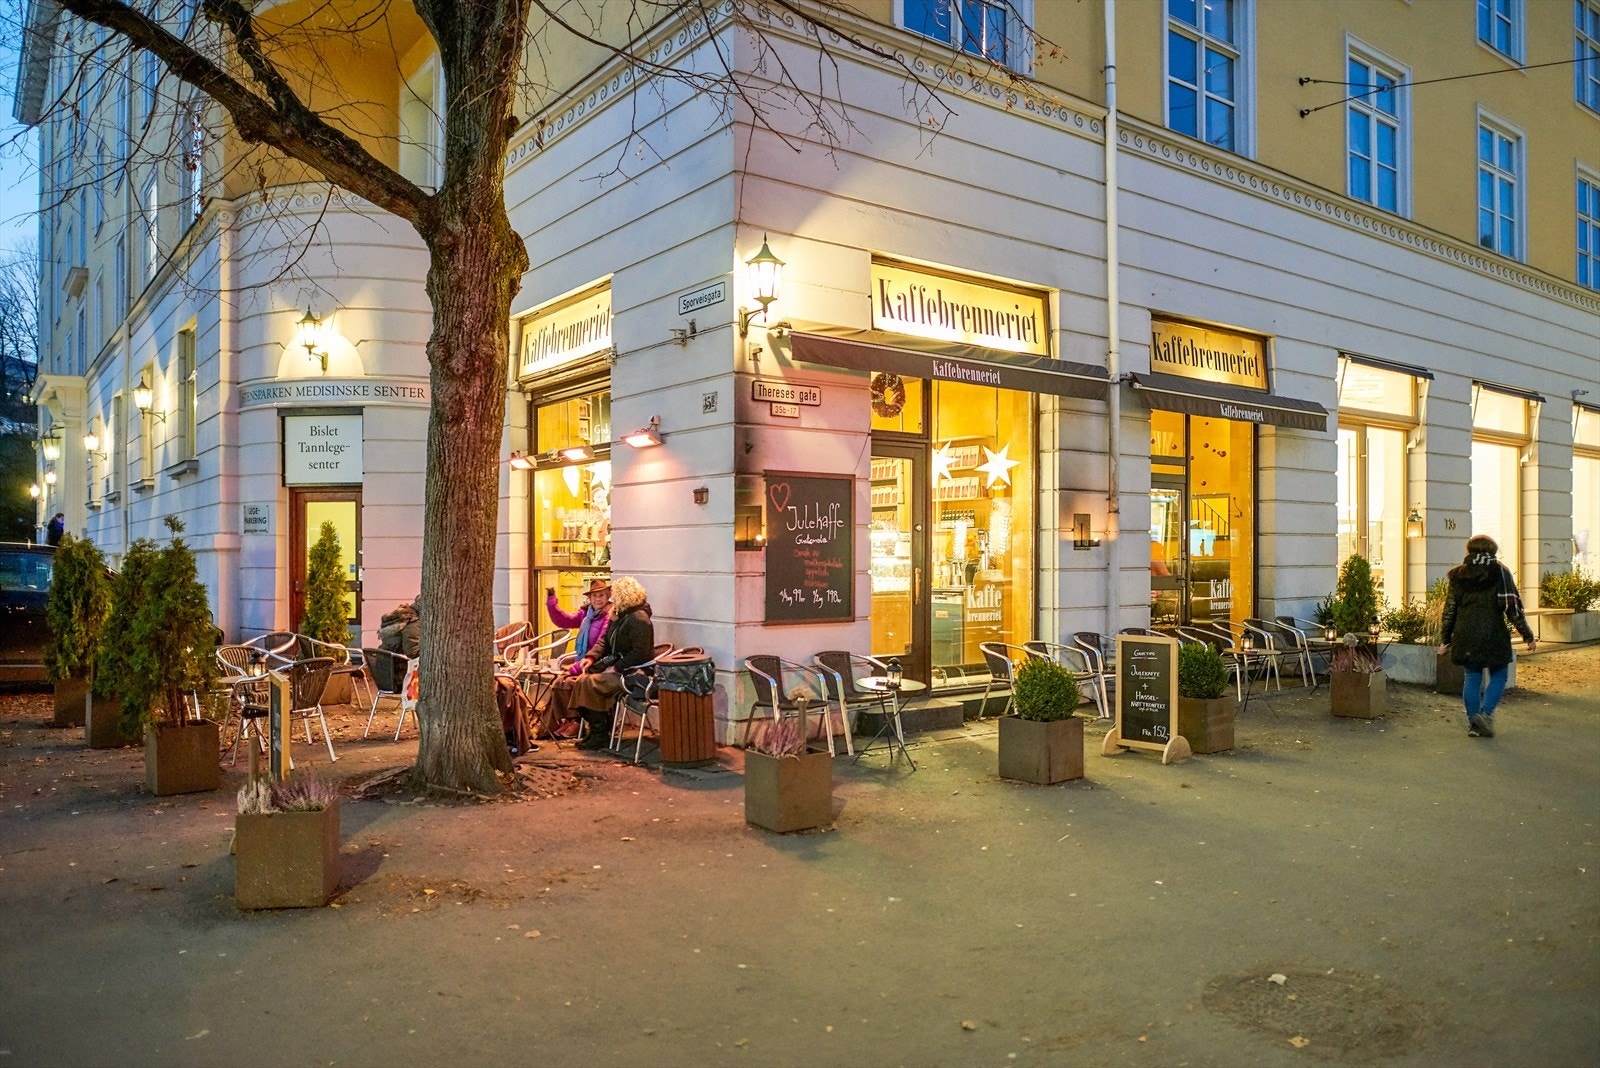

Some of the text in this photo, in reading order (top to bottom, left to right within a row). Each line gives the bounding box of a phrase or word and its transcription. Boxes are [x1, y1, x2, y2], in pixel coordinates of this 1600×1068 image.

[682, 289, 721, 311] Sporveisgata
[878, 278, 1039, 344] Kaffebrenneriet
[523, 303, 611, 366] Kaffebrenneriet
[1152, 331, 1260, 378] Kaffebrenneriet
[932, 360, 1001, 385] Kaffebrenneriet
[295, 385, 370, 397] MEDISINSKE
[373, 386, 425, 399] SENTER
[757, 384, 817, 403] Thereses gate
[774, 405, 797, 415] 35b-17
[1220, 404, 1264, 422] Kaffebrenneriet
[309, 425, 338, 437] Bislet
[297, 442, 350, 455] Tannlege-
[308, 460, 340, 470] senter
[786, 502, 845, 540] Julekaffe
[967, 584, 1002, 608] Kaffe
[1210, 578, 1234, 599] Kaffe
[967, 609, 1002, 622] brenneriet
